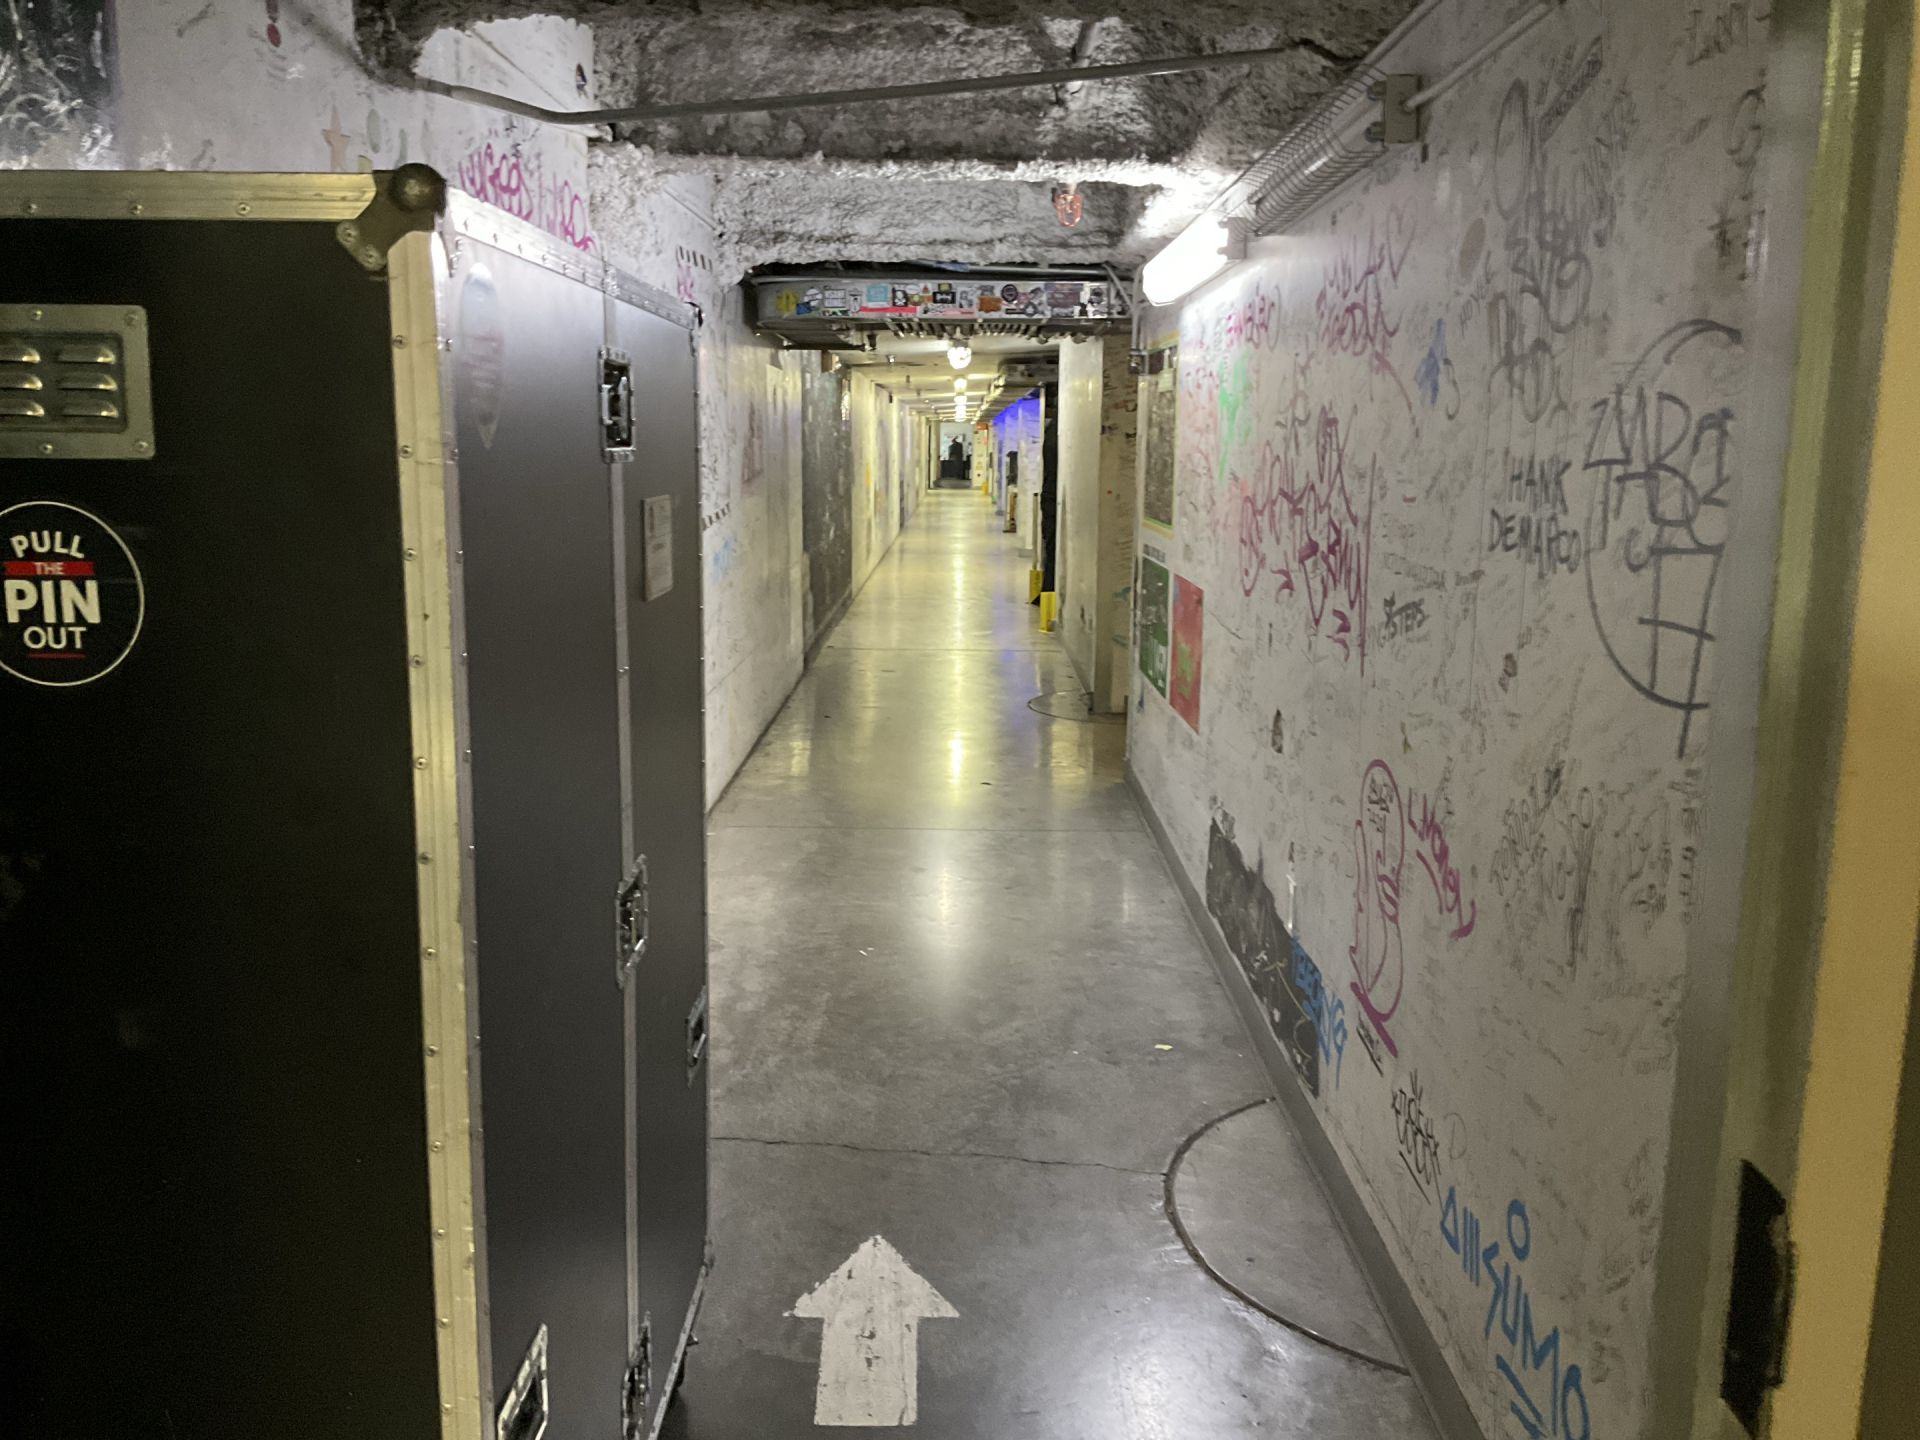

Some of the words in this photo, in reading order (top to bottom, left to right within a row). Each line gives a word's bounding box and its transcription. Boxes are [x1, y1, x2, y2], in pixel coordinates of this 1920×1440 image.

[1507, 453, 1573, 516] HANK
[10, 530, 85, 559] PULL
[33, 561, 65, 576] THE
[4, 579, 101, 624] PIN
[23, 625, 87, 649] OUT
